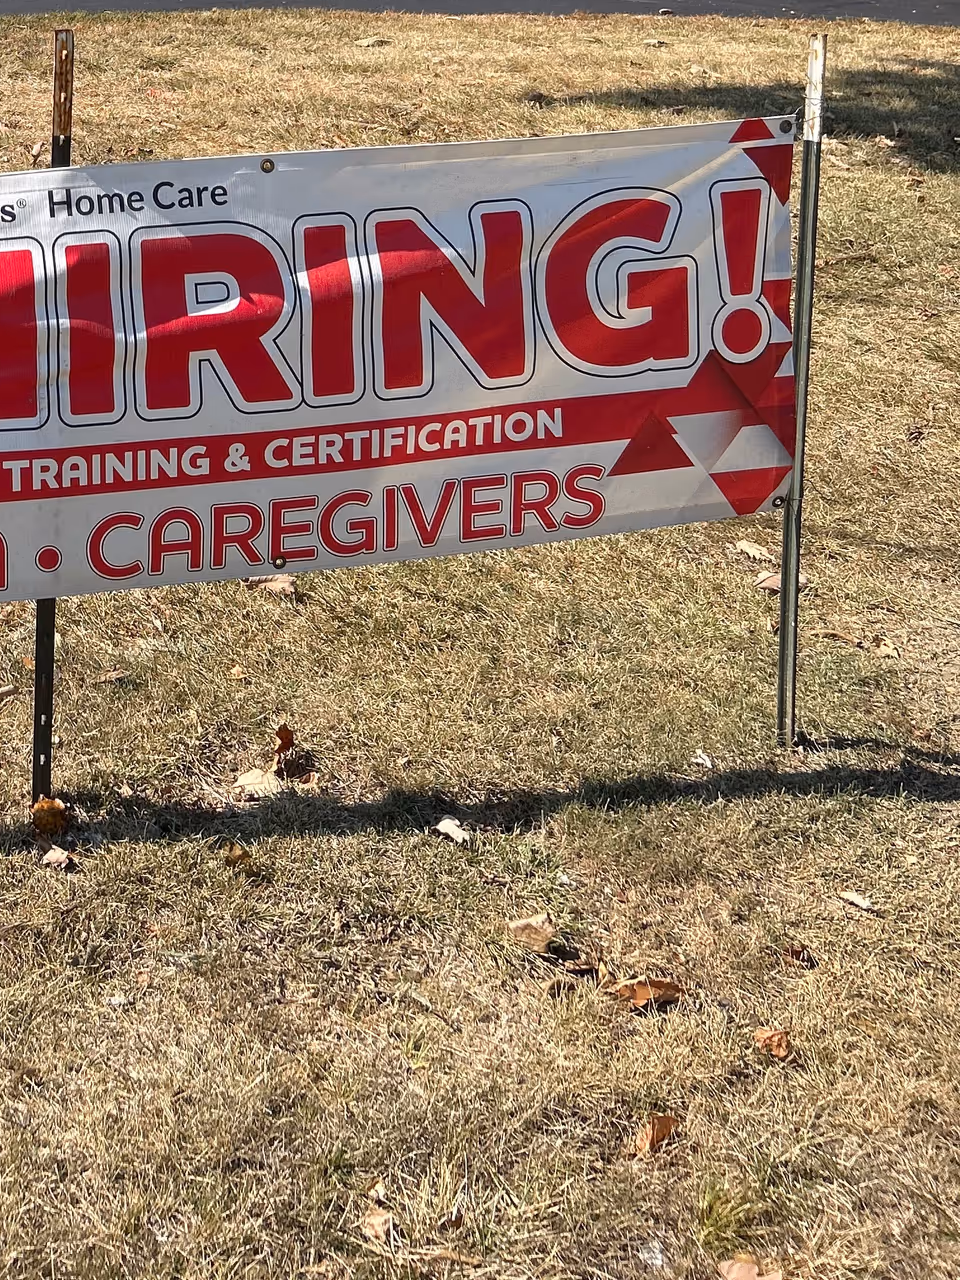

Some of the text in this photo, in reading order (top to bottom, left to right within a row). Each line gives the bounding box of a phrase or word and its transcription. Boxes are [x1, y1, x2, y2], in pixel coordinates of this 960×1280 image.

[47, 188, 145, 219] Home
[152, 180, 229, 211] Care
[2, 445, 211, 492] TRAINING
[223, 442, 251, 472] &
[264, 406, 564, 468] CERTIFICATION
[85, 463, 608, 581] CAREGIVERS
